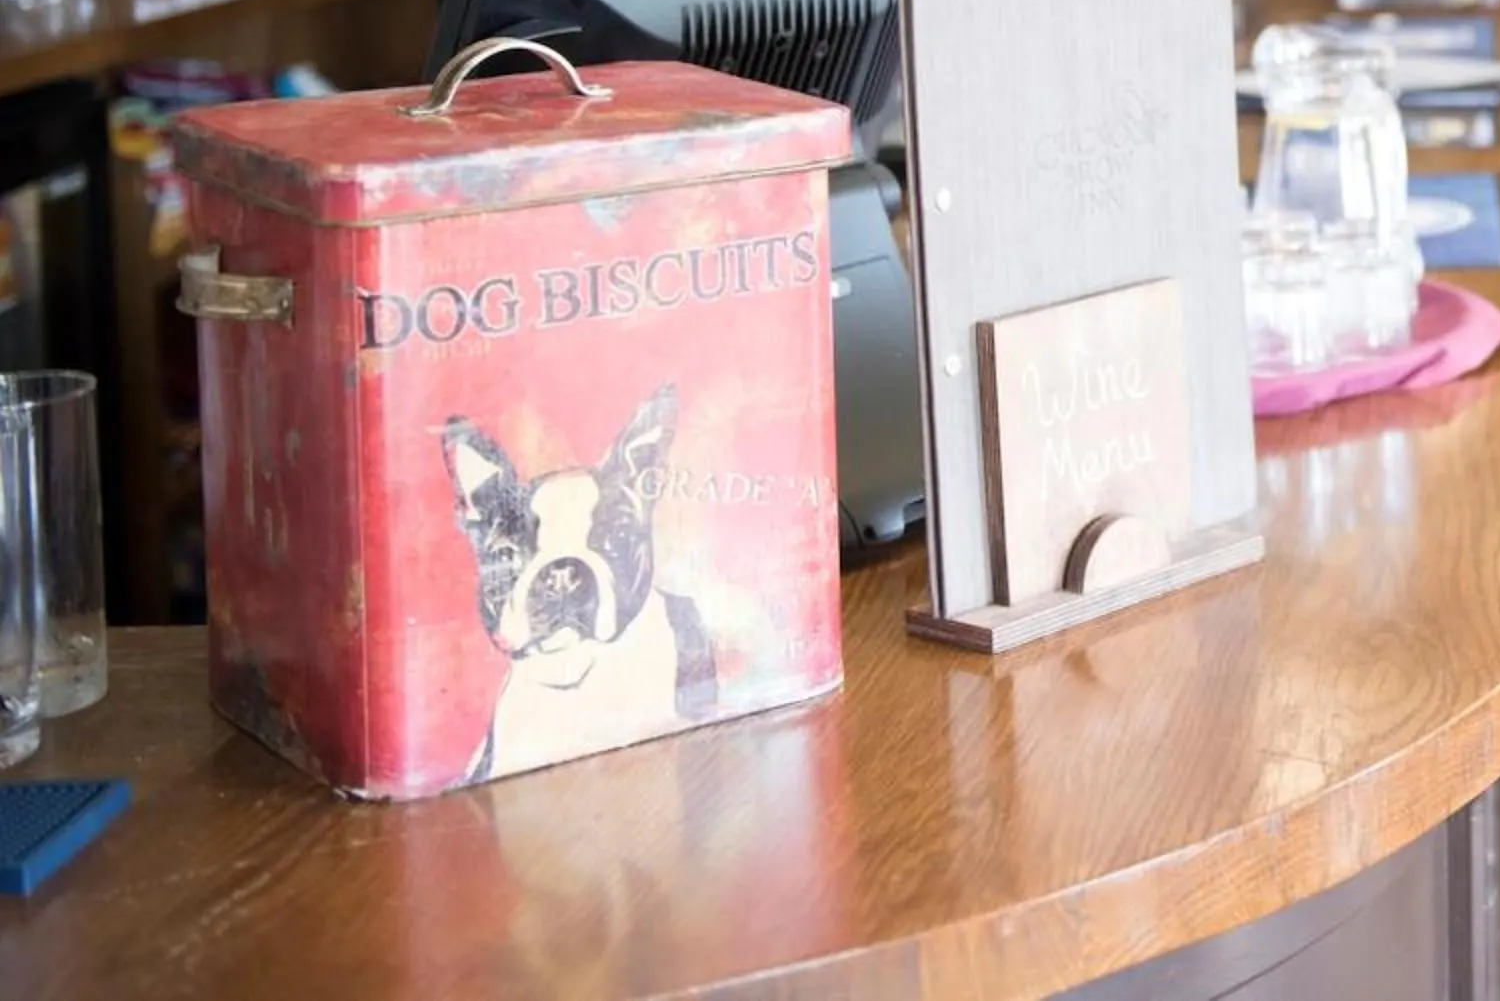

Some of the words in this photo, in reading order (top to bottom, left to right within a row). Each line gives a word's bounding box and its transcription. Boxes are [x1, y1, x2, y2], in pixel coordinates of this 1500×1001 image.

[358, 277, 521, 350] DOG
[538, 230, 818, 326] BISCUITS
[1020, 345, 1150, 427] Wine
[636, 467, 776, 504] GRADE
[1040, 430, 1158, 502] Menu
